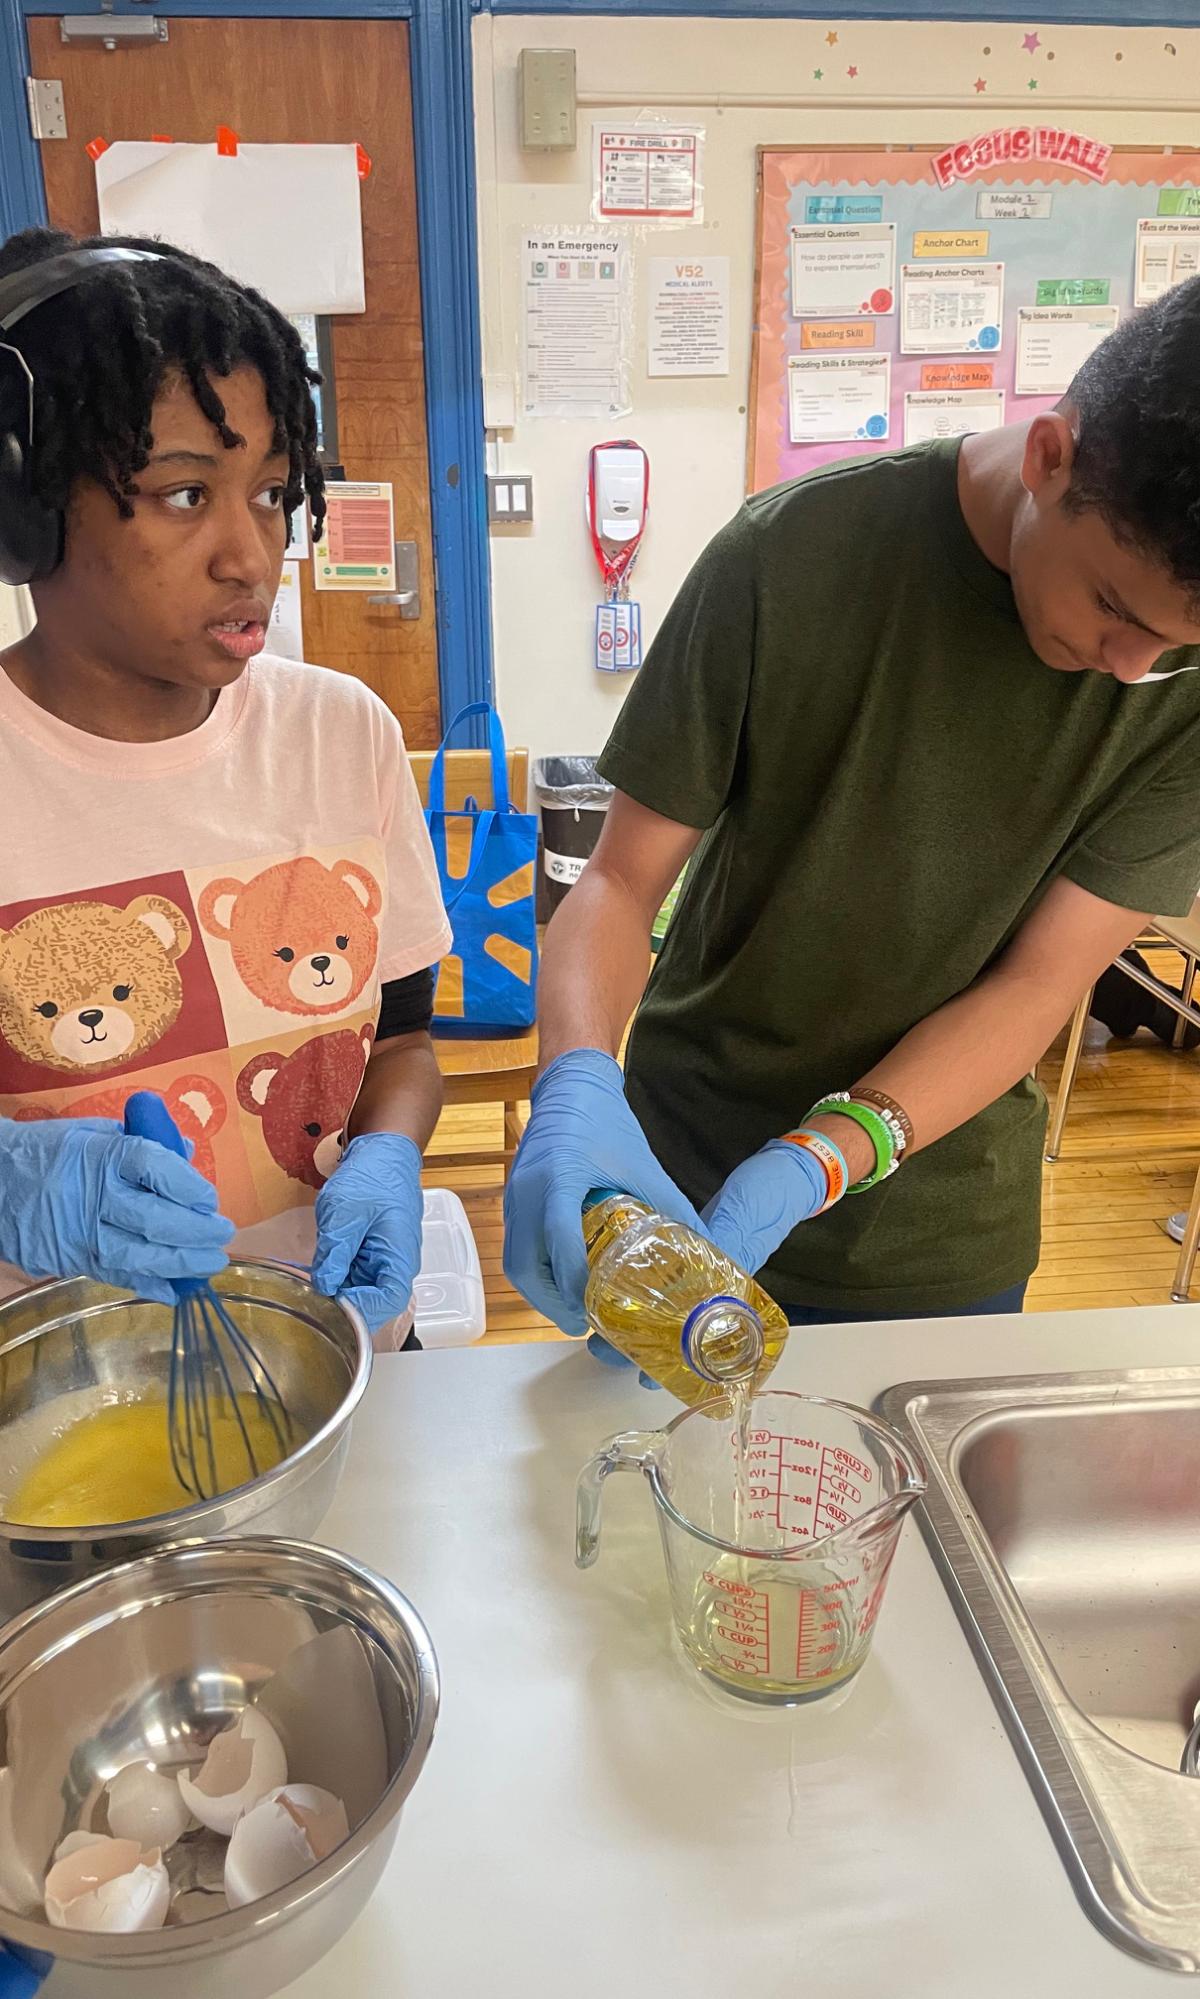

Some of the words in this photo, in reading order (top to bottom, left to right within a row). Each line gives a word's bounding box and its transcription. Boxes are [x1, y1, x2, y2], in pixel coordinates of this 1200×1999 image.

[647, 140, 669, 148] DRILL
[936, 130, 1031, 185] FOCUS
[1039, 130, 1107, 176] WALL
[991, 195, 1022, 204] Module
[845, 205, 881, 215] Question
[995, 208, 1017, 217] Week
[1160, 223, 1167, 231] of
[1180, 223, 1200, 232] Week
[794, 230, 826, 239] Essential
[827, 230, 860, 238] Question
[527, 240, 538, 249] In
[541, 241, 555, 249] an
[557, 240, 619, 252] Emergency
[922, 239, 954, 248] Anchor
[955, 239, 980, 247] Chart
[675, 265, 704, 278] V52
[903, 270, 934, 279] Reading
[934, 269, 960, 278] Anchor
[961, 268, 985, 277] Charts
[690, 280, 713, 288] ALERTS
[1020, 312, 1032, 321] Big
[1033, 312, 1050, 320] Idea
[1050, 311, 1073, 320] Words
[811, 330, 844, 340] Reading
[846, 329, 864, 338] Skill
[822, 359, 840, 368] Skills
[847, 358, 883, 368] Strategies
[926, 373, 971, 383] Knowledge
[972, 373, 989, 381] Map
[907, 396, 946, 405] Knowledge
[947, 395, 963, 404] Map
[812, 1141, 835, 1163] BEST
[718, 1580, 752, 1597] CUPS
[823, 1576, 860, 1594] 500ml
[820, 1620, 841, 1632] 300
[730, 1632, 755, 1645] CUP
